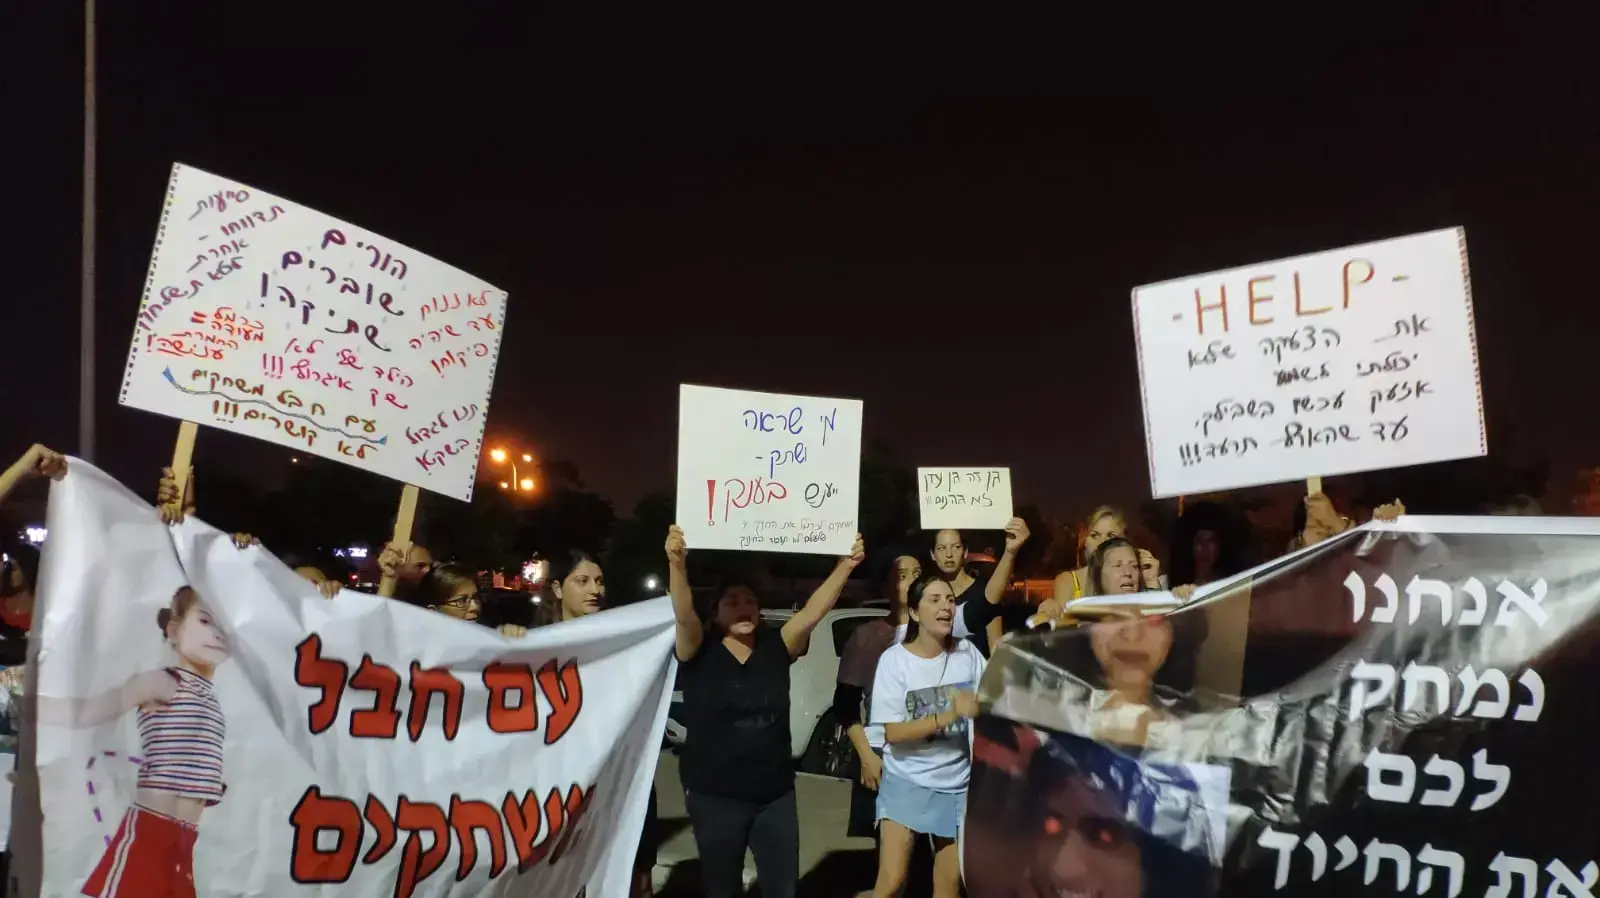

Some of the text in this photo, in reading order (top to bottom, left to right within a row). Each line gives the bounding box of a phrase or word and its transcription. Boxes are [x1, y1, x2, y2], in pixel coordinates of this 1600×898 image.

[320, 228, 408, 280] הורים
[282, 250, 404, 316] שוברים
[466, 289, 494, 308] לא
[1194, 258, 1376, 336] HELP
[214, 306, 264, 330] כרמל
[260, 272, 392, 353] שתיקה!
[408, 312, 496, 350] עד שיהיה
[170, 331, 239, 350] החמרת
[284, 338, 324, 354] לא
[1188, 313, 1433, 371] את הצעקה שלא
[430, 342, 488, 379] פיקוח!
[1356, 350, 1418, 378] יכולתי
[192, 368, 377, 433] עם חבל משחקים
[370, 388, 409, 410] שק
[452, 404, 478, 422] תנו
[1370, 379, 1434, 416] אזעק
[742, 406, 837, 446] מי שראה
[1271, 420, 1361, 448] שהארץ
[1369, 414, 1408, 443] עד
[338, 440, 379, 460] לא
[770, 442, 808, 480] ושתק
[924, 472, 943, 493] עדן
[965, 472, 982, 483] זה
[986, 470, 1001, 492] גן
[970, 492, 993, 508] לא
[1344, 570, 1550, 630] אנחנו
[294, 632, 584, 746] עם חבל
[1350, 658, 1545, 722] נמחק
[1363, 746, 1512, 812] לכם
[1256, 824, 1600, 898] את החיוך
